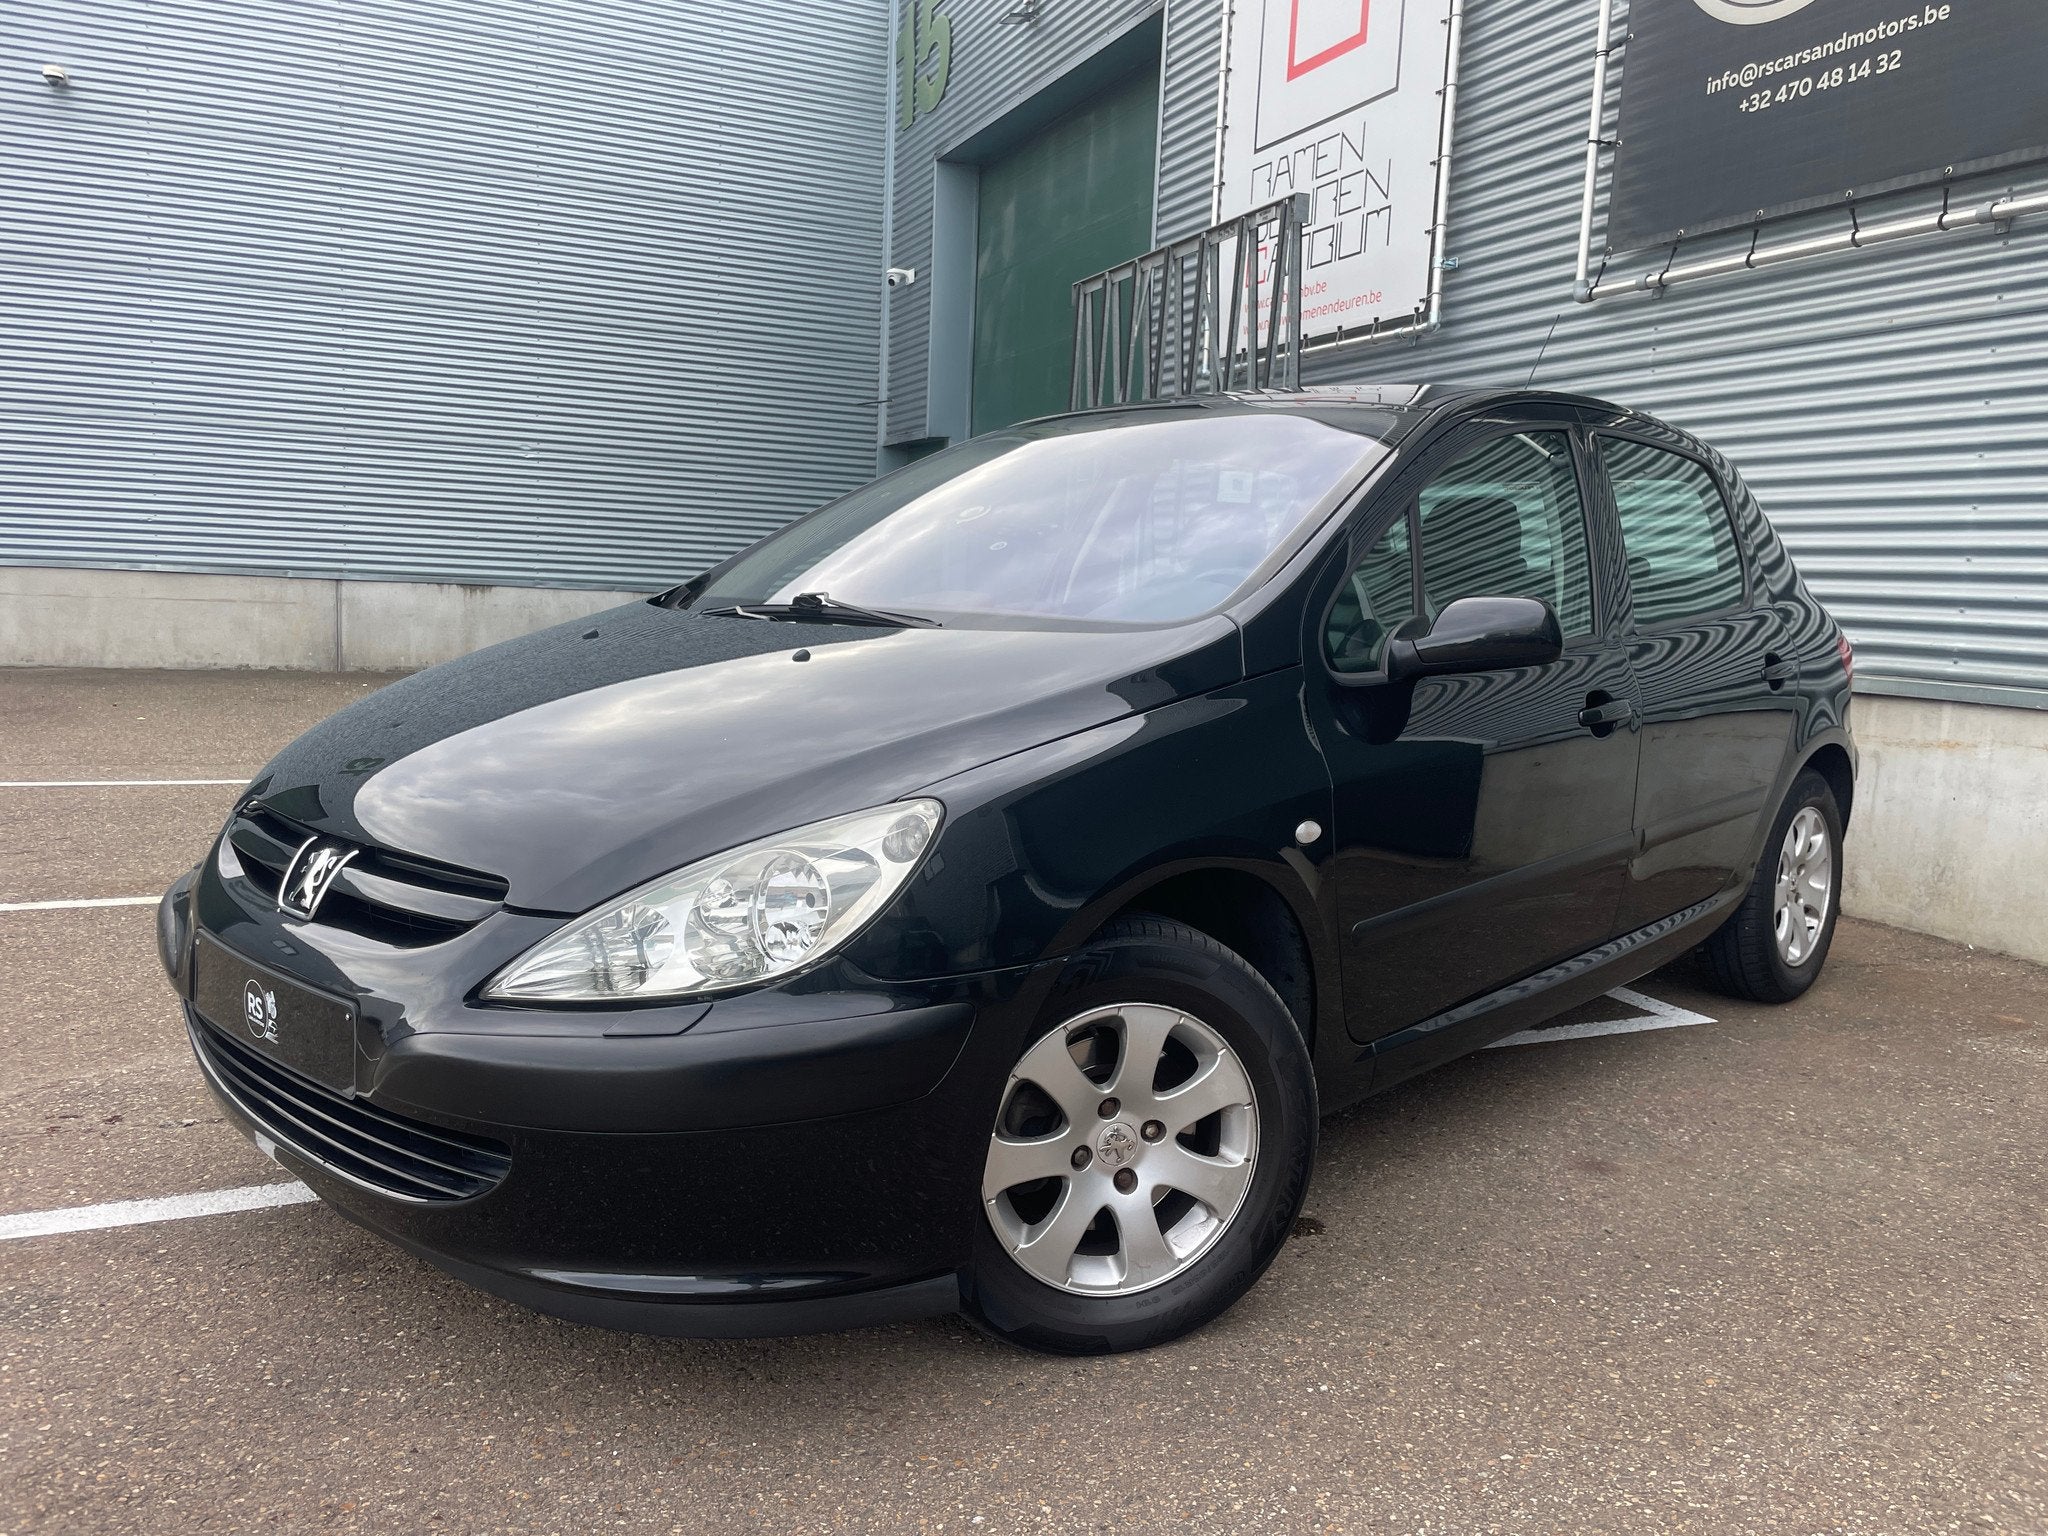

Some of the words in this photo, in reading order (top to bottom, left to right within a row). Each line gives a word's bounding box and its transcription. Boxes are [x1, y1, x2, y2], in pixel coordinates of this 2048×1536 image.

[1706, 4, 1951, 95] info@rscarsandmotors.be
[1739, 90, 1771, 112] +32
[1774, 77, 1813, 103] 470
[1816, 67, 1844, 91] 48
[1847, 59, 1871, 83] 14
[1876, 50, 1902, 74] 32
[1250, 121, 1366, 205] RAMEN
[247, 991, 263, 1020] RS
